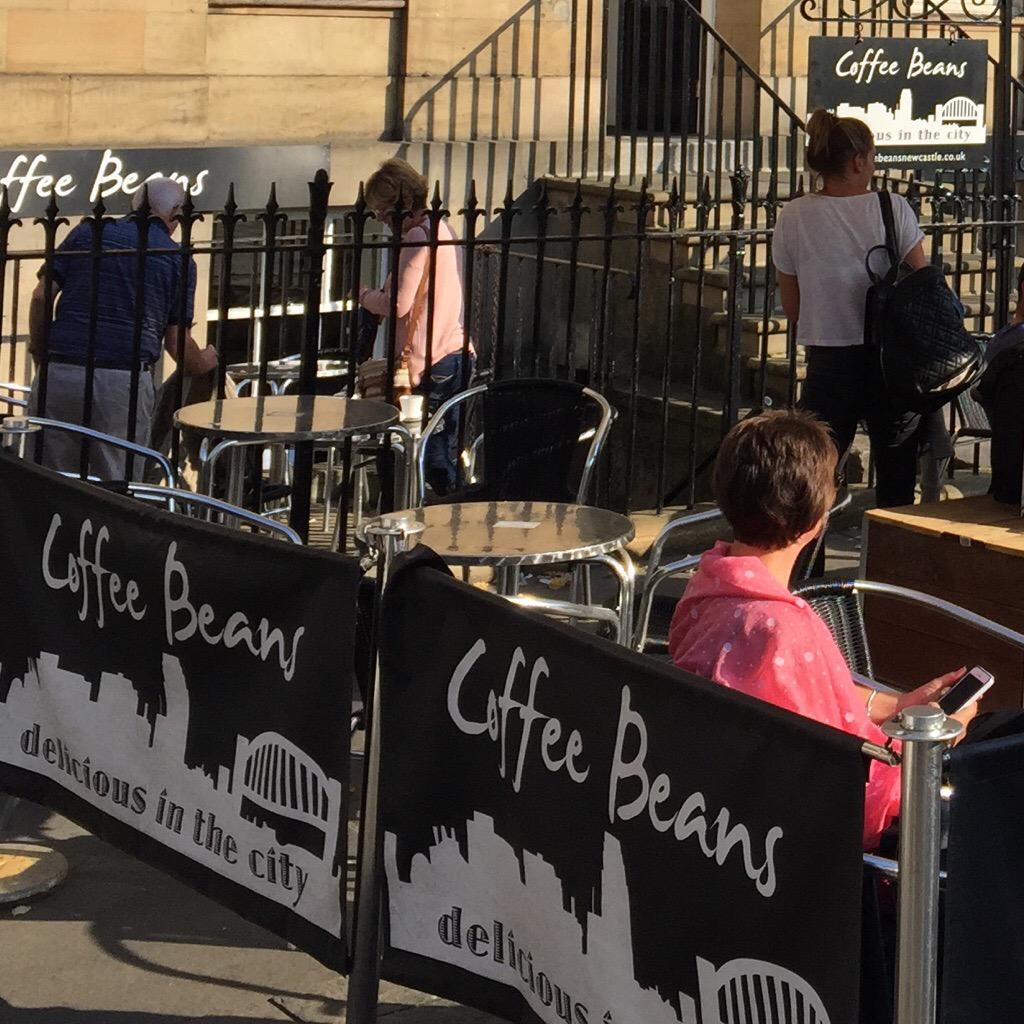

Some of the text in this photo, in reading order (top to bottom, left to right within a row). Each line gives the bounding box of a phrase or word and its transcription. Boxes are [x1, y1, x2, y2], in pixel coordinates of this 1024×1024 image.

[835, 46, 967, 84] Coffee Beans
[0, 148, 209, 213] ffee Bens
[899, 129, 912, 141] in
[919, 129, 941, 141] the
[947, 128, 971, 142] city
[42, 512, 305, 681] Coffee Beans
[20, 722, 310, 907] delicious in the city
[447, 638, 784, 898] Coffee Beans
[437, 905, 589, 1024] delicious
